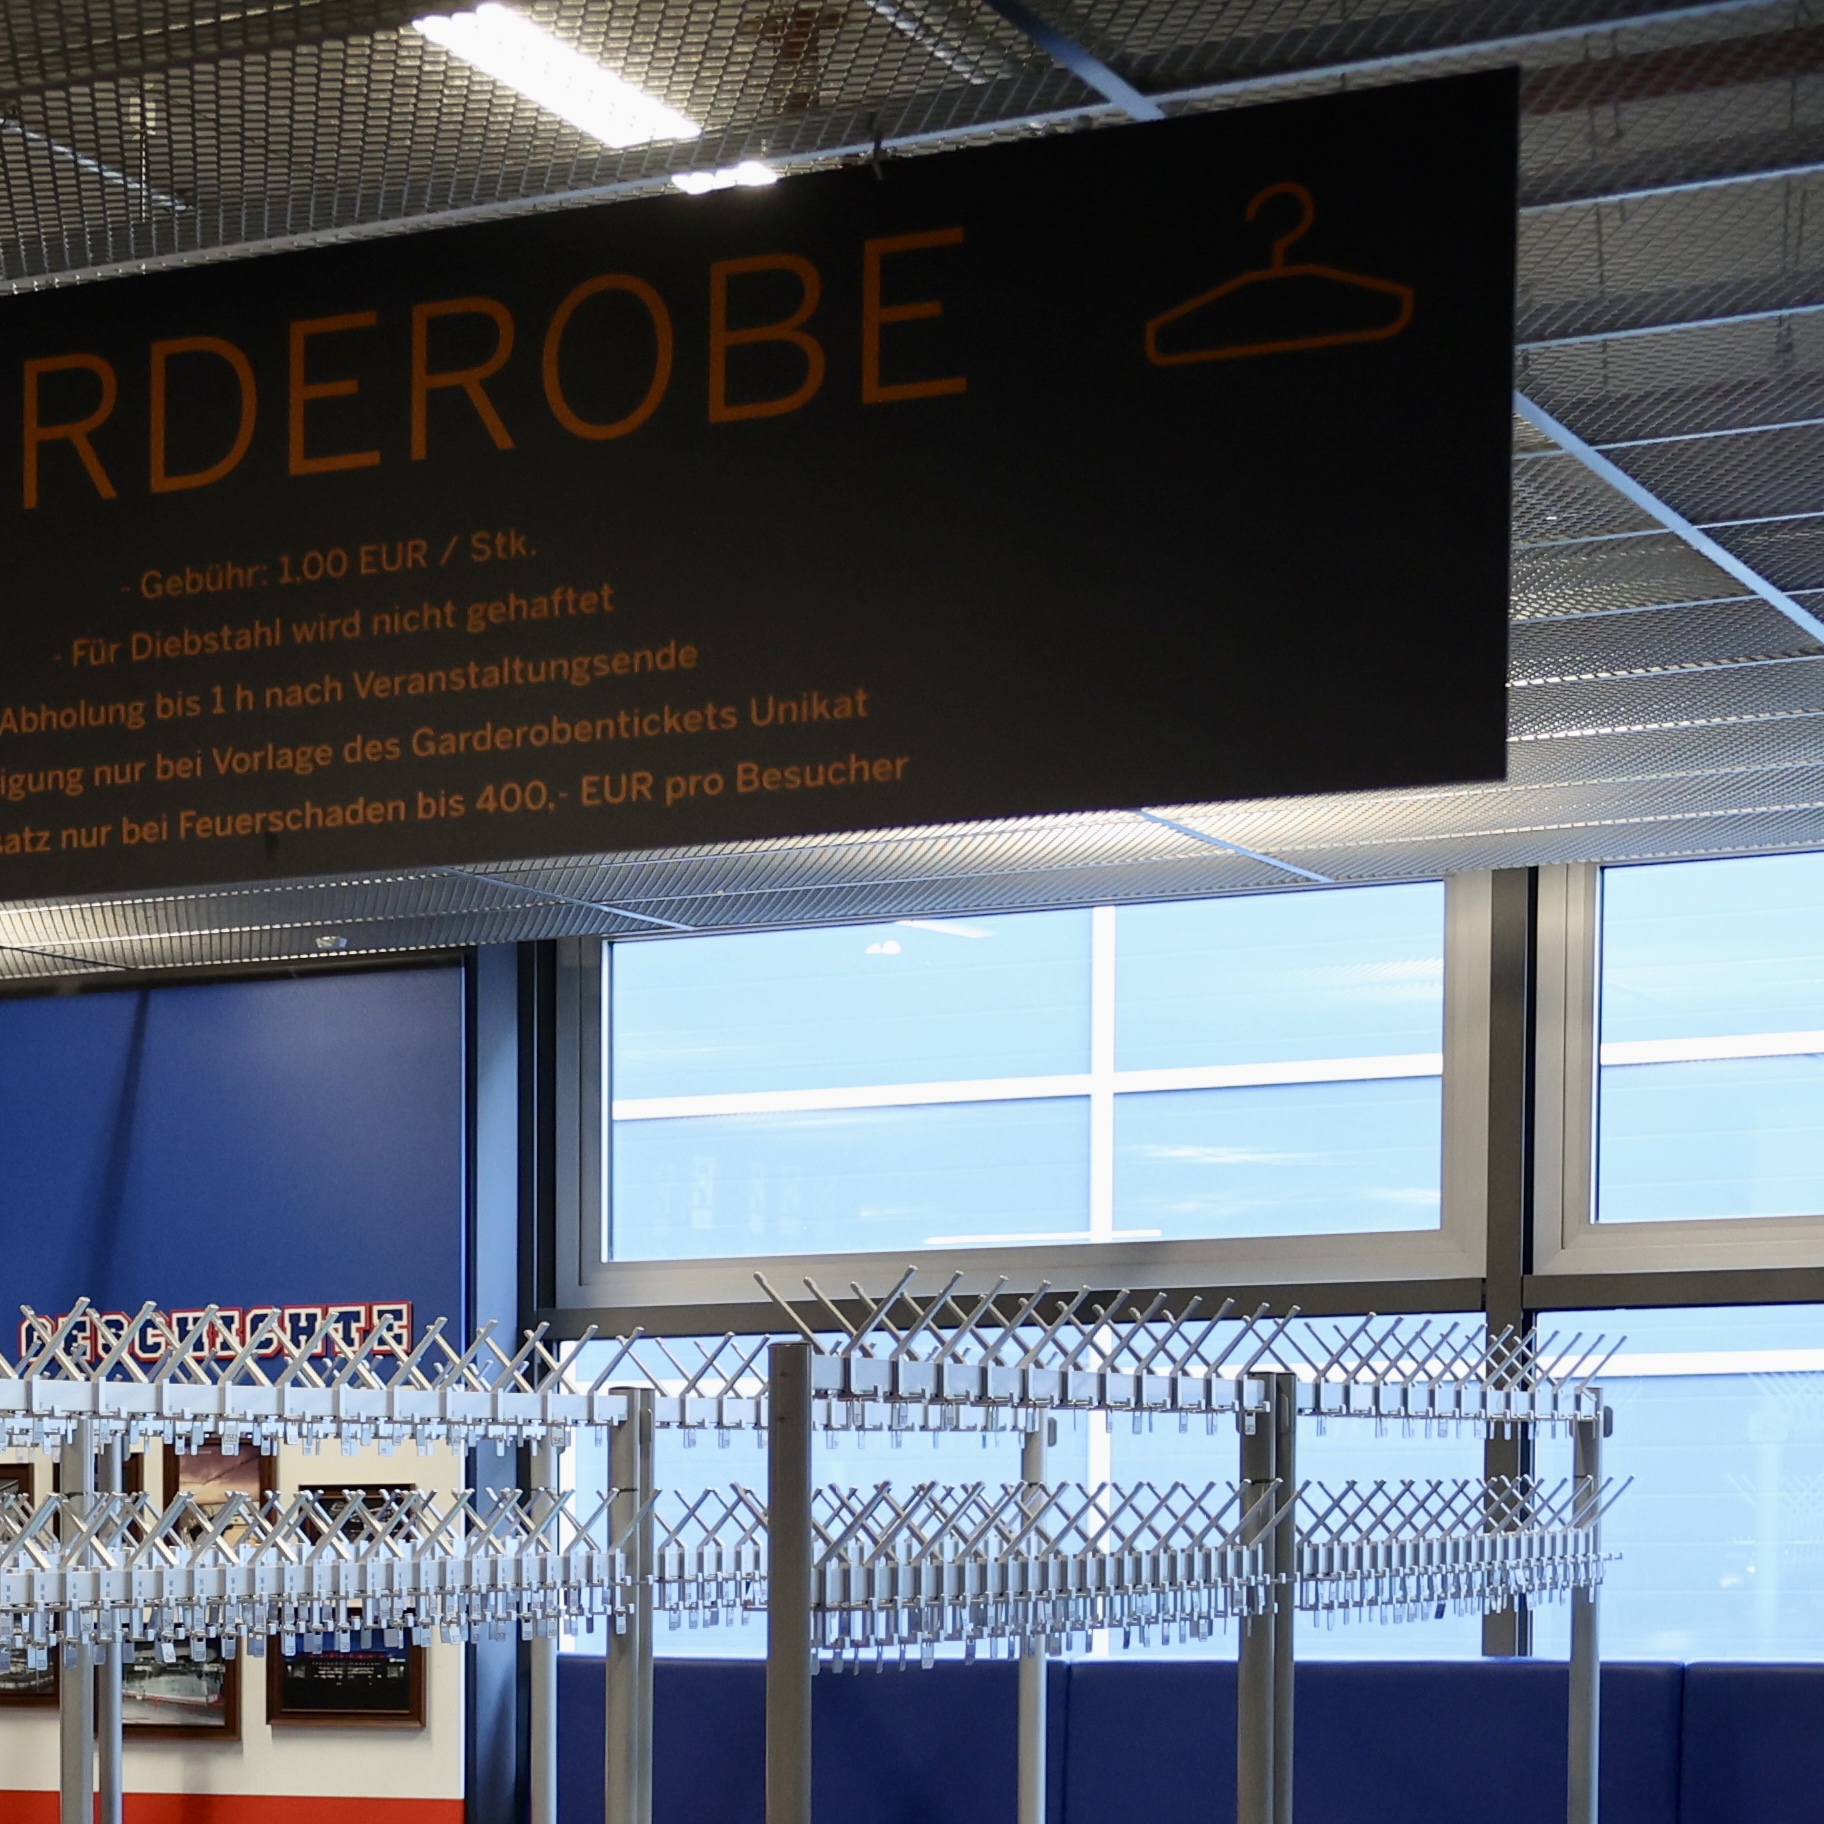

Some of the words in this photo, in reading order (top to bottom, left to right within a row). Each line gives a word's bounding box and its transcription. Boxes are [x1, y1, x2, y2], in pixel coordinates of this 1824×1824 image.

[138, 560, 269, 601] Gebühr:
[357, 537, 430, 577] EUR
[469, 527, 538, 564] Stk.
[70, 636, 122, 668] Für
[129, 616, 285, 663] Diebstahl
[289, 608, 364, 646] wird
[370, 598, 459, 637] nicht
[464, 582, 616, 635] gehaftet
[153, 690, 205, 721] bis
[209, 684, 228, 716] 1
[233, 681, 258, 713] h
[262, 673, 346, 710] nach
[351, 638, 701, 701] Veranstaltungsende
[91, 759, 149, 787] nur
[153, 749, 206, 783] bei
[210, 741, 337, 778] Vorlage
[340, 733, 405, 766] des
[409, 701, 741, 760] Garderobentickets
[747, 686, 871, 728] Unikat
[59, 822, 116, 850] nur
[119, 812, 171, 847] bei
[176, 794, 410, 841] Feuerschaden
[414, 788, 470, 822] bis
[578, 769, 656, 808] EUR
[662, 770, 728, 808] pro
[734, 751, 912, 795] Besucher
